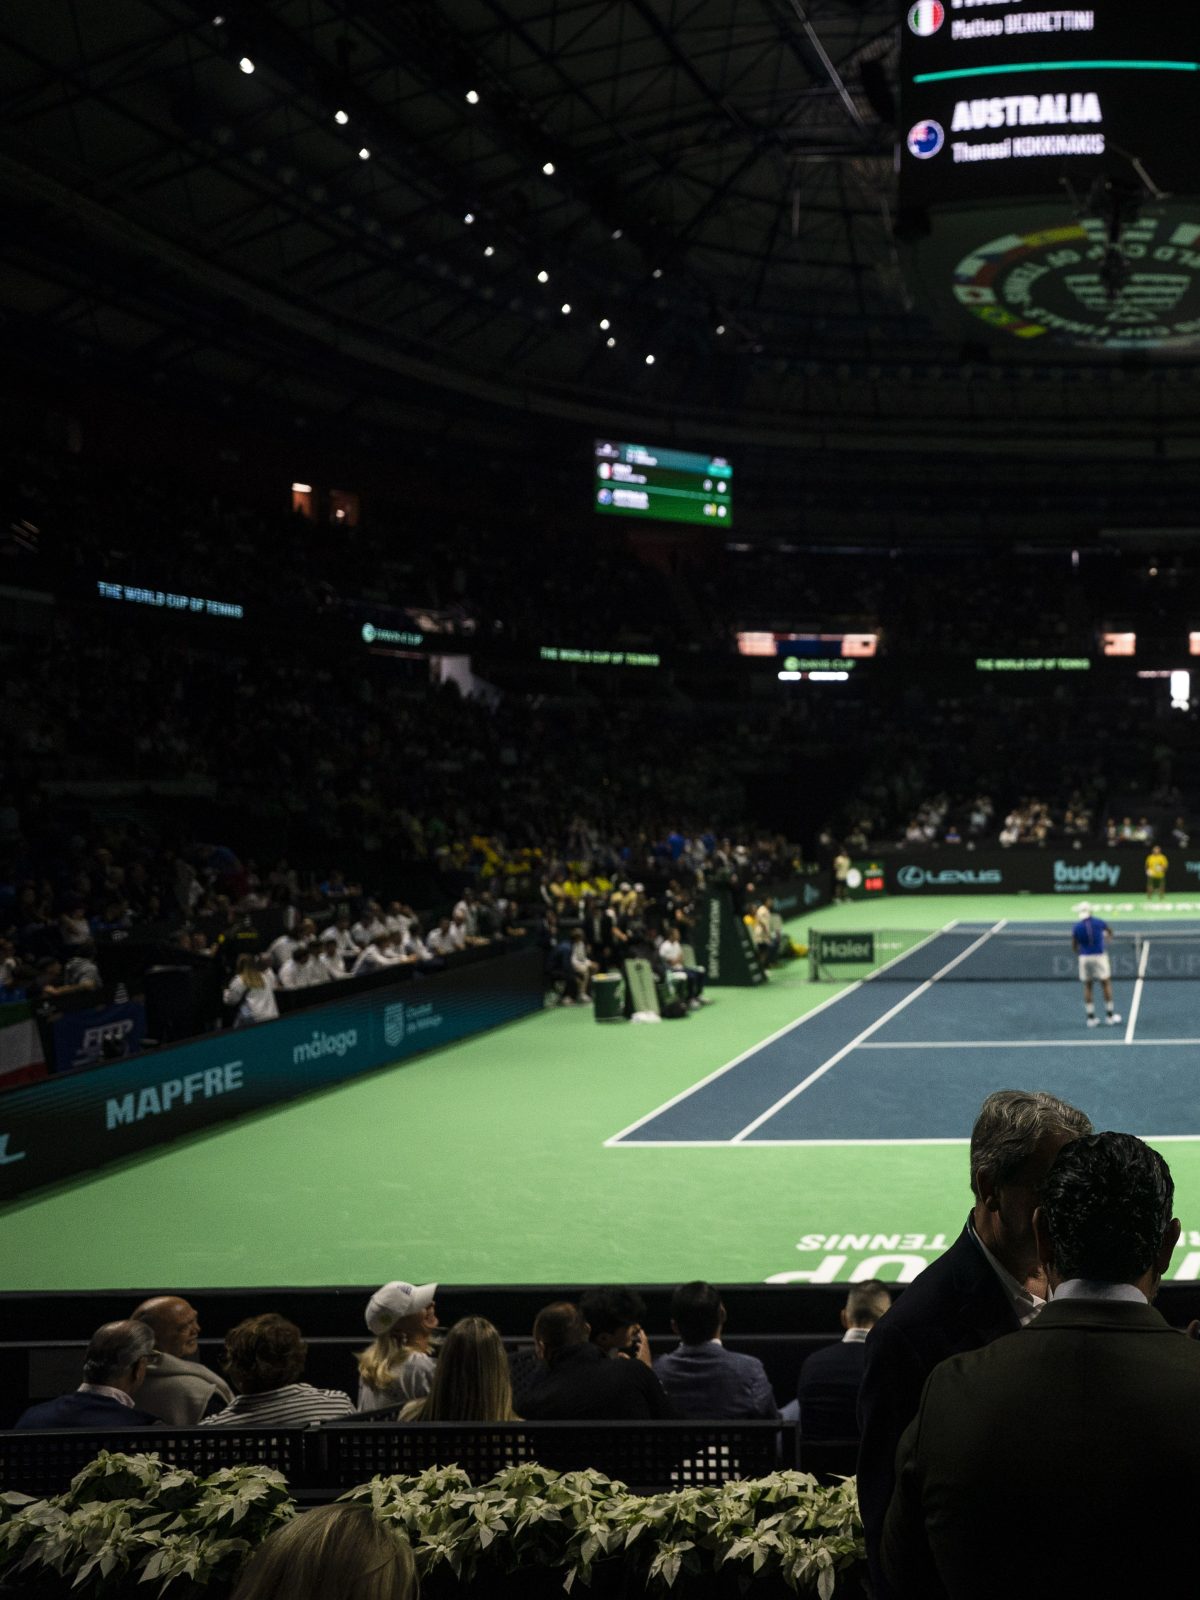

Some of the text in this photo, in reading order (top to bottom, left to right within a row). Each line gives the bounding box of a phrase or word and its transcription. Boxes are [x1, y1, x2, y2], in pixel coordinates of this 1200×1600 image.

[950, 92, 1103, 132] AUSTRALIA
[926, 868, 1003, 884] LEXUS
[1053, 860, 1121, 888] buddy
[105, 1060, 244, 1131] MAPFRE
[795, 1233, 950, 1251] TENNIS
